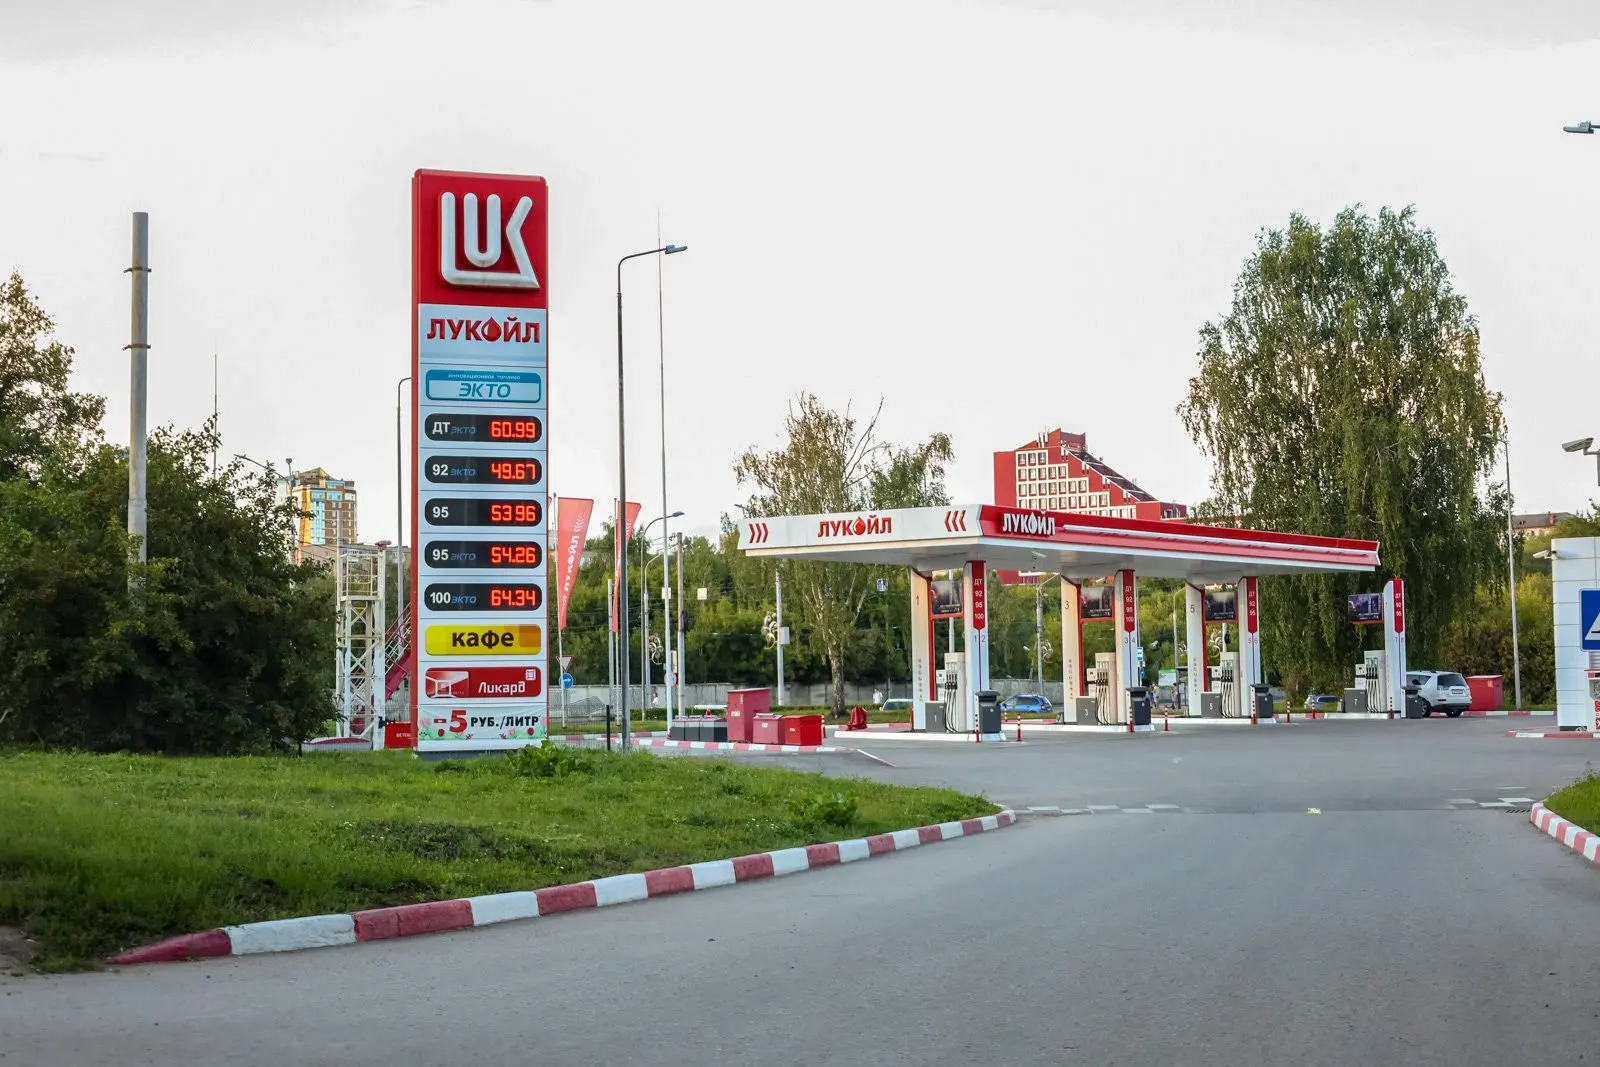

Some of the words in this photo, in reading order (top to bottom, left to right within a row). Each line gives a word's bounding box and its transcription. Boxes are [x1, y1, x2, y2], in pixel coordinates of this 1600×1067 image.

[427, 316, 540, 343] ЛУКОЙЛ
[459, 383, 511, 398] ЭКТО
[432, 421, 450, 435] ДТ
[491, 421, 536, 438] 60.99
[432, 464, 449, 476] 92
[491, 463, 536, 480] 49.67
[432, 506, 449, 518] 95
[817, 514, 893, 538] ЛУКОЙЛ
[1002, 510, 1056, 536] ЛУКОЙЛ
[432, 549, 449, 561] 95
[491, 546, 536, 564] 54.26
[974, 578, 983, 586] ДТ
[430, 591, 451, 604] 100
[491, 589, 536, 606] 64.34
[1064, 600, 1070, 610] 3
[1190, 604, 1195, 614] 5
[452, 630, 514, 649] кафе
[478, 681, 526, 696] Ликард
